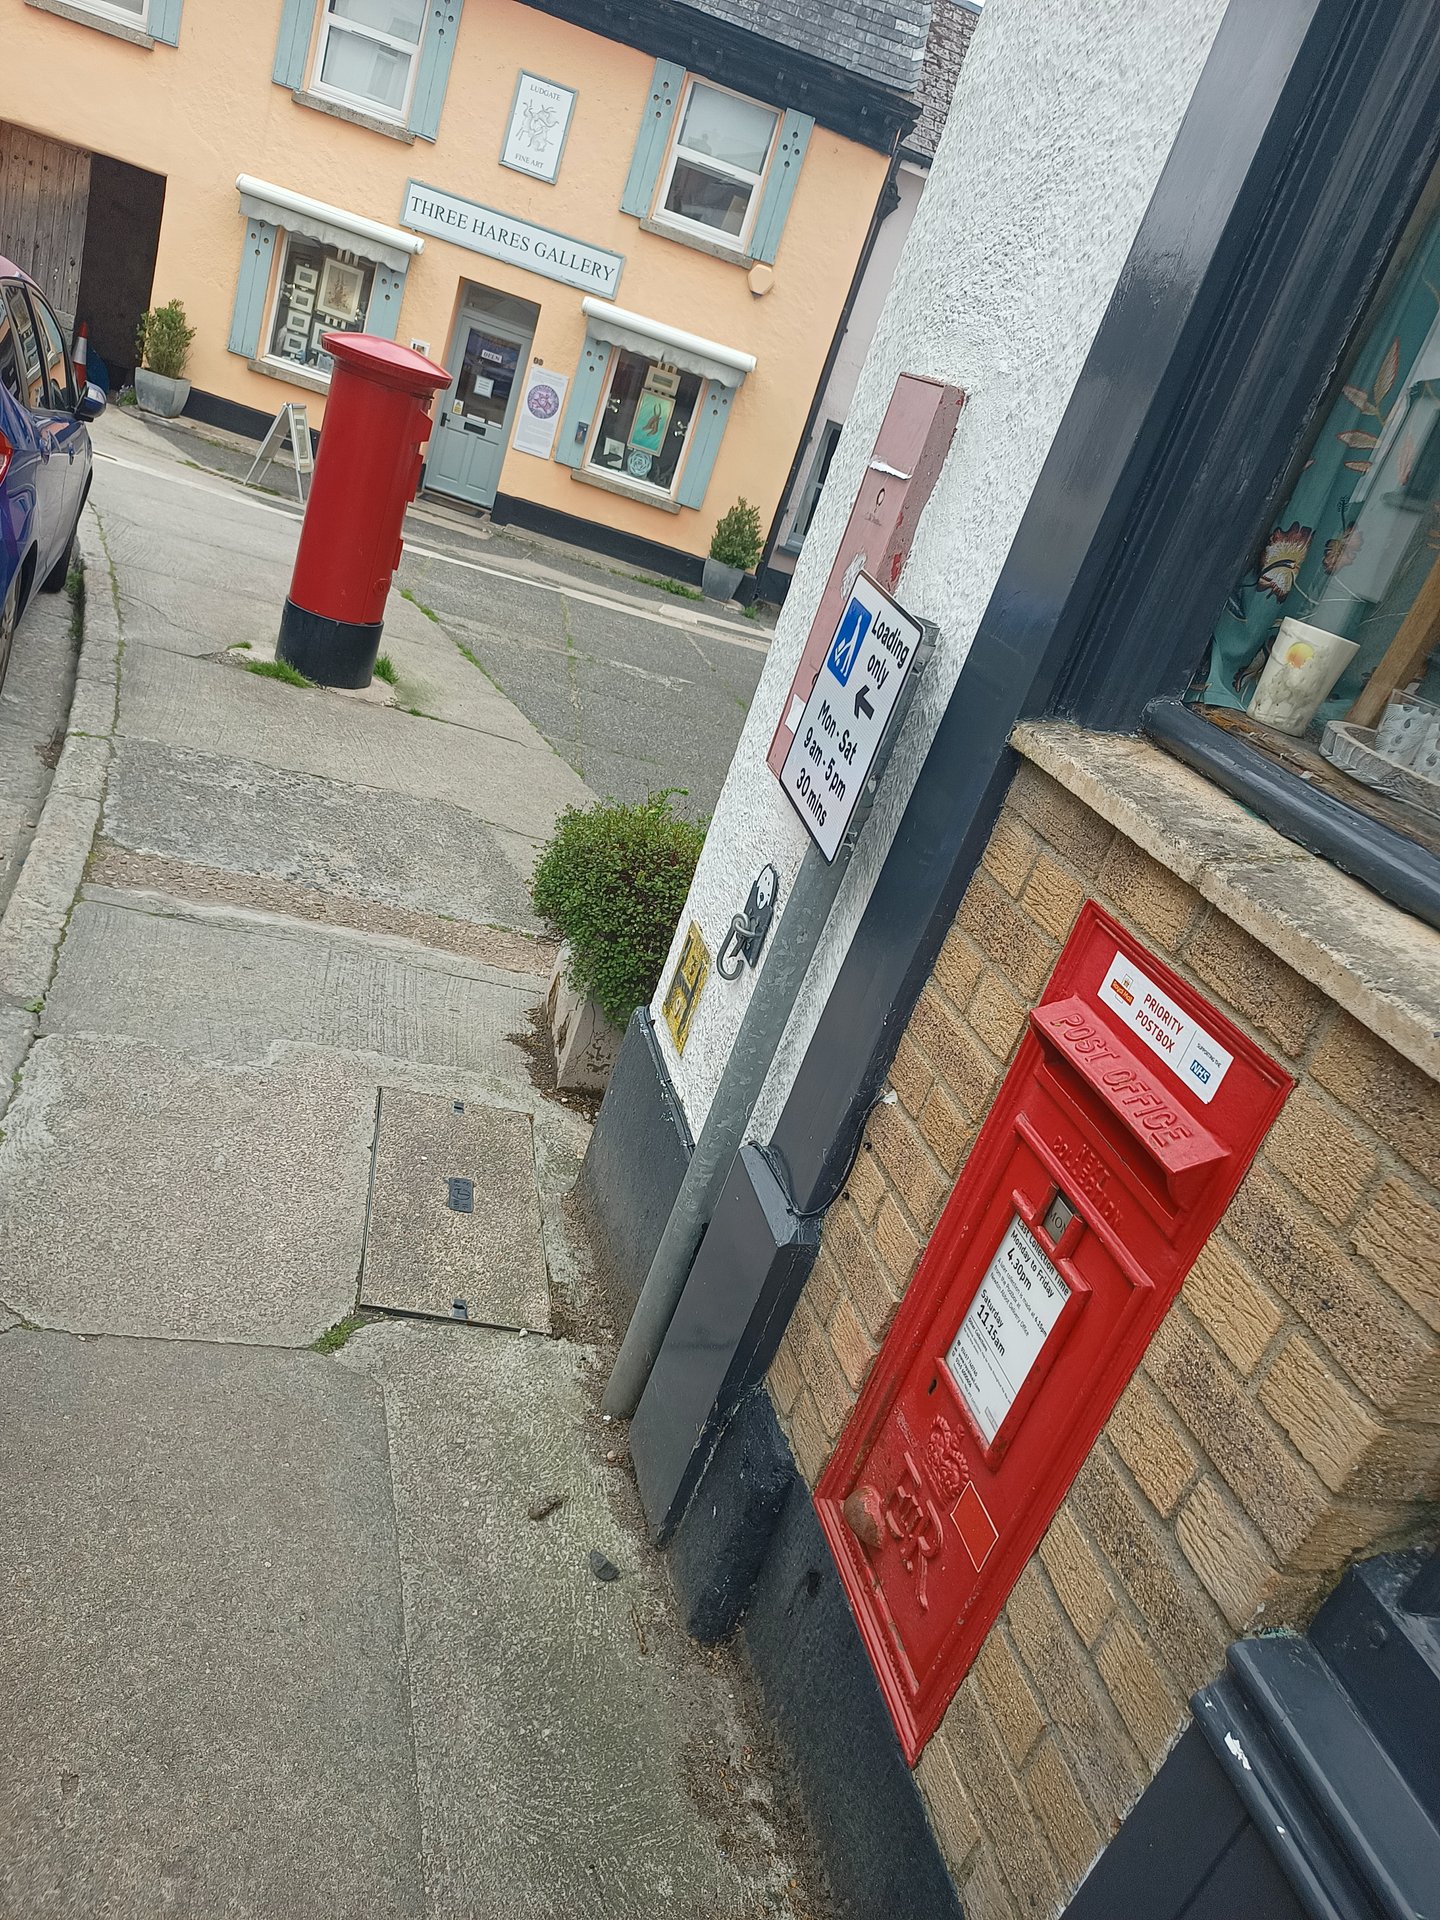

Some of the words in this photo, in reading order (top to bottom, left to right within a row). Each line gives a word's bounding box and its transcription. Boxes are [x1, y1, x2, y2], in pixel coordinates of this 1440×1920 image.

[529, 84, 561, 102] LUDGATE
[515, 153, 531, 165] FINE
[531, 159, 544, 169] ART
[411, 195, 469, 230] THREE
[471, 217, 530, 252] HARES
[534, 241, 616, 282] GALLERY
[870, 610, 909, 669] Loading
[867, 653, 891, 689] only
[818, 699, 837, 739] Mon
[838, 729, 857, 766] Sat
[796, 767, 811, 796] 30
[806, 788, 827, 827] mins
[1111, 979, 1125, 996] Royal
[1121, 989, 1133, 1004] Mail
[1142, 992, 1184, 1037] PRIORITY
[1134, 1008, 1176, 1054] POSTBOX
[1050, 1012, 1121, 1063] POST
[1102, 1069, 1193, 1148] OFFICE
[1189, 1059, 1210, 1084] NHS
[1007, 1247, 1032, 1291] 4.30pm
[1010, 1229, 1031, 1263] Monday
[1030, 1260, 1037, 1272] to
[1036, 1269, 1055, 1298] Friday
[1017, 1217, 1030, 1238] Last
[1029, 1234, 1056, 1275] Collection
[1054, 1272, 1071, 1296] Time
[977, 1304, 1005, 1357] 11.15am
[981, 1289, 1004, 1328] Saturday
